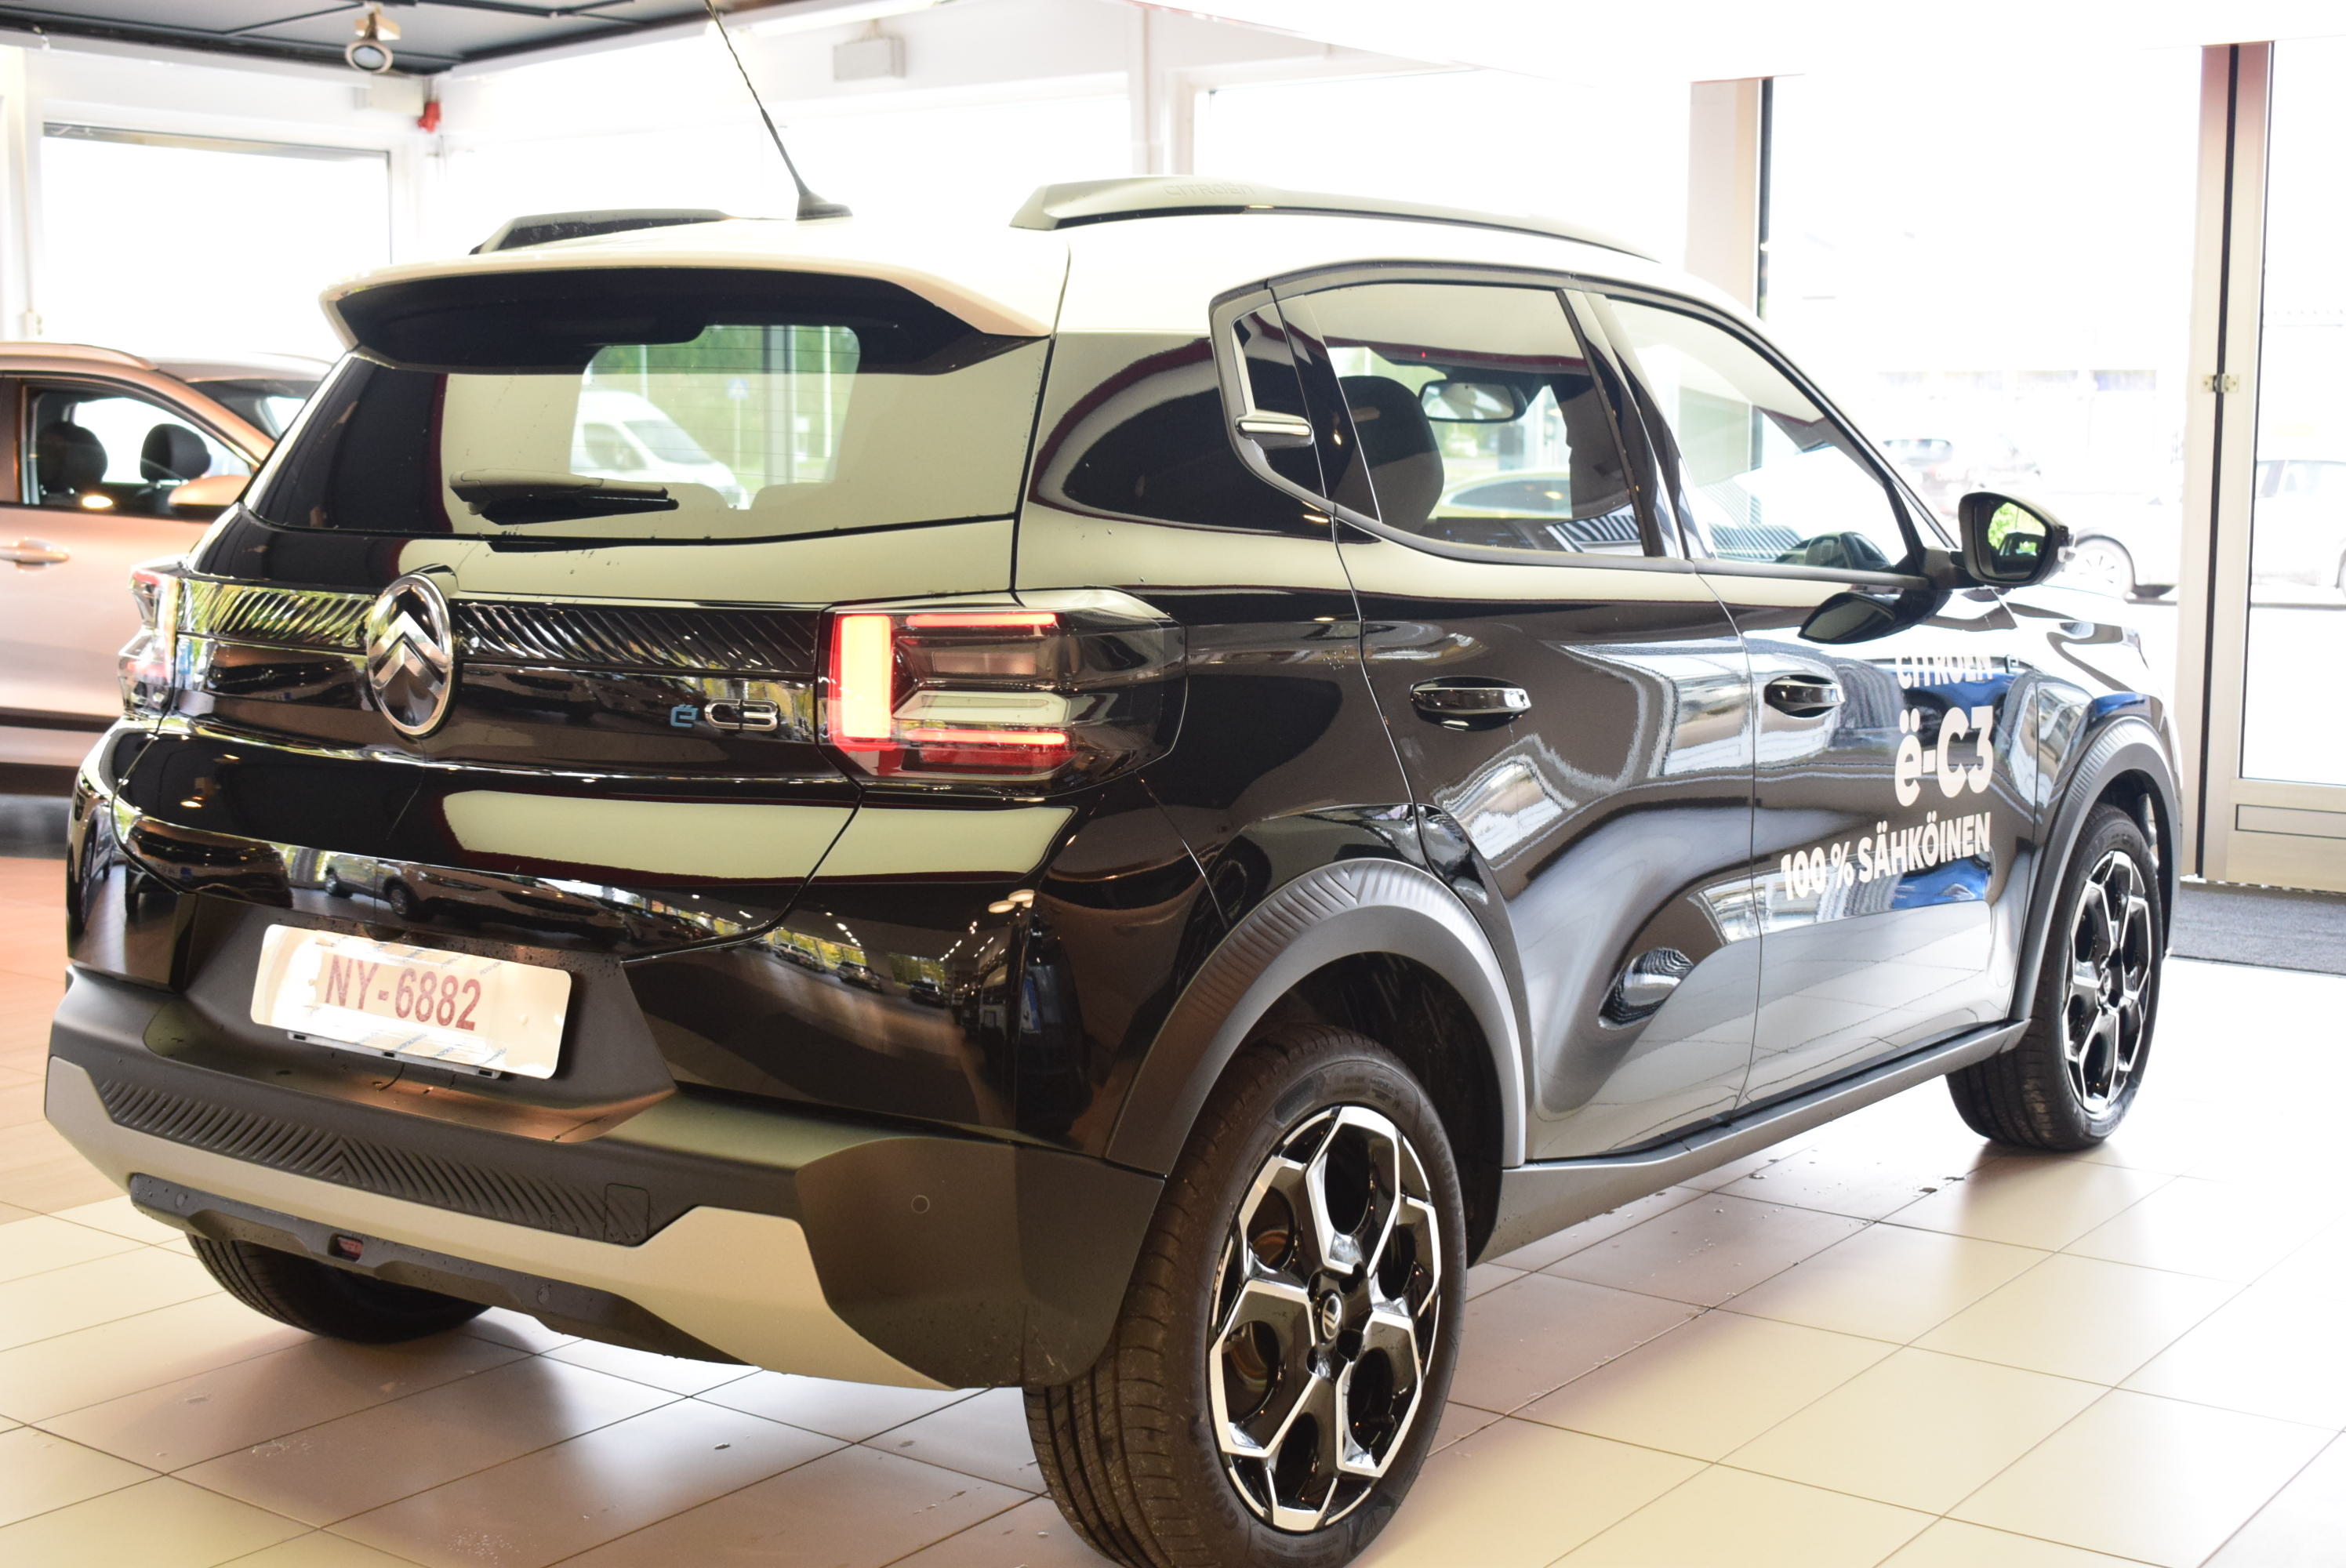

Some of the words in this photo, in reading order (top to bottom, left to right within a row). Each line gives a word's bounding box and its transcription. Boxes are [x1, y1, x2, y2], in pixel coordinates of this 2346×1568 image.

[1894, 706, 1994, 807] ë-C3
[1781, 846, 1826, 901] 100
[1831, 841, 1854, 889] %
[1858, 811, 1992, 883] SÄHKÖINEN
[326, 956, 481, 1031] NY-6882
